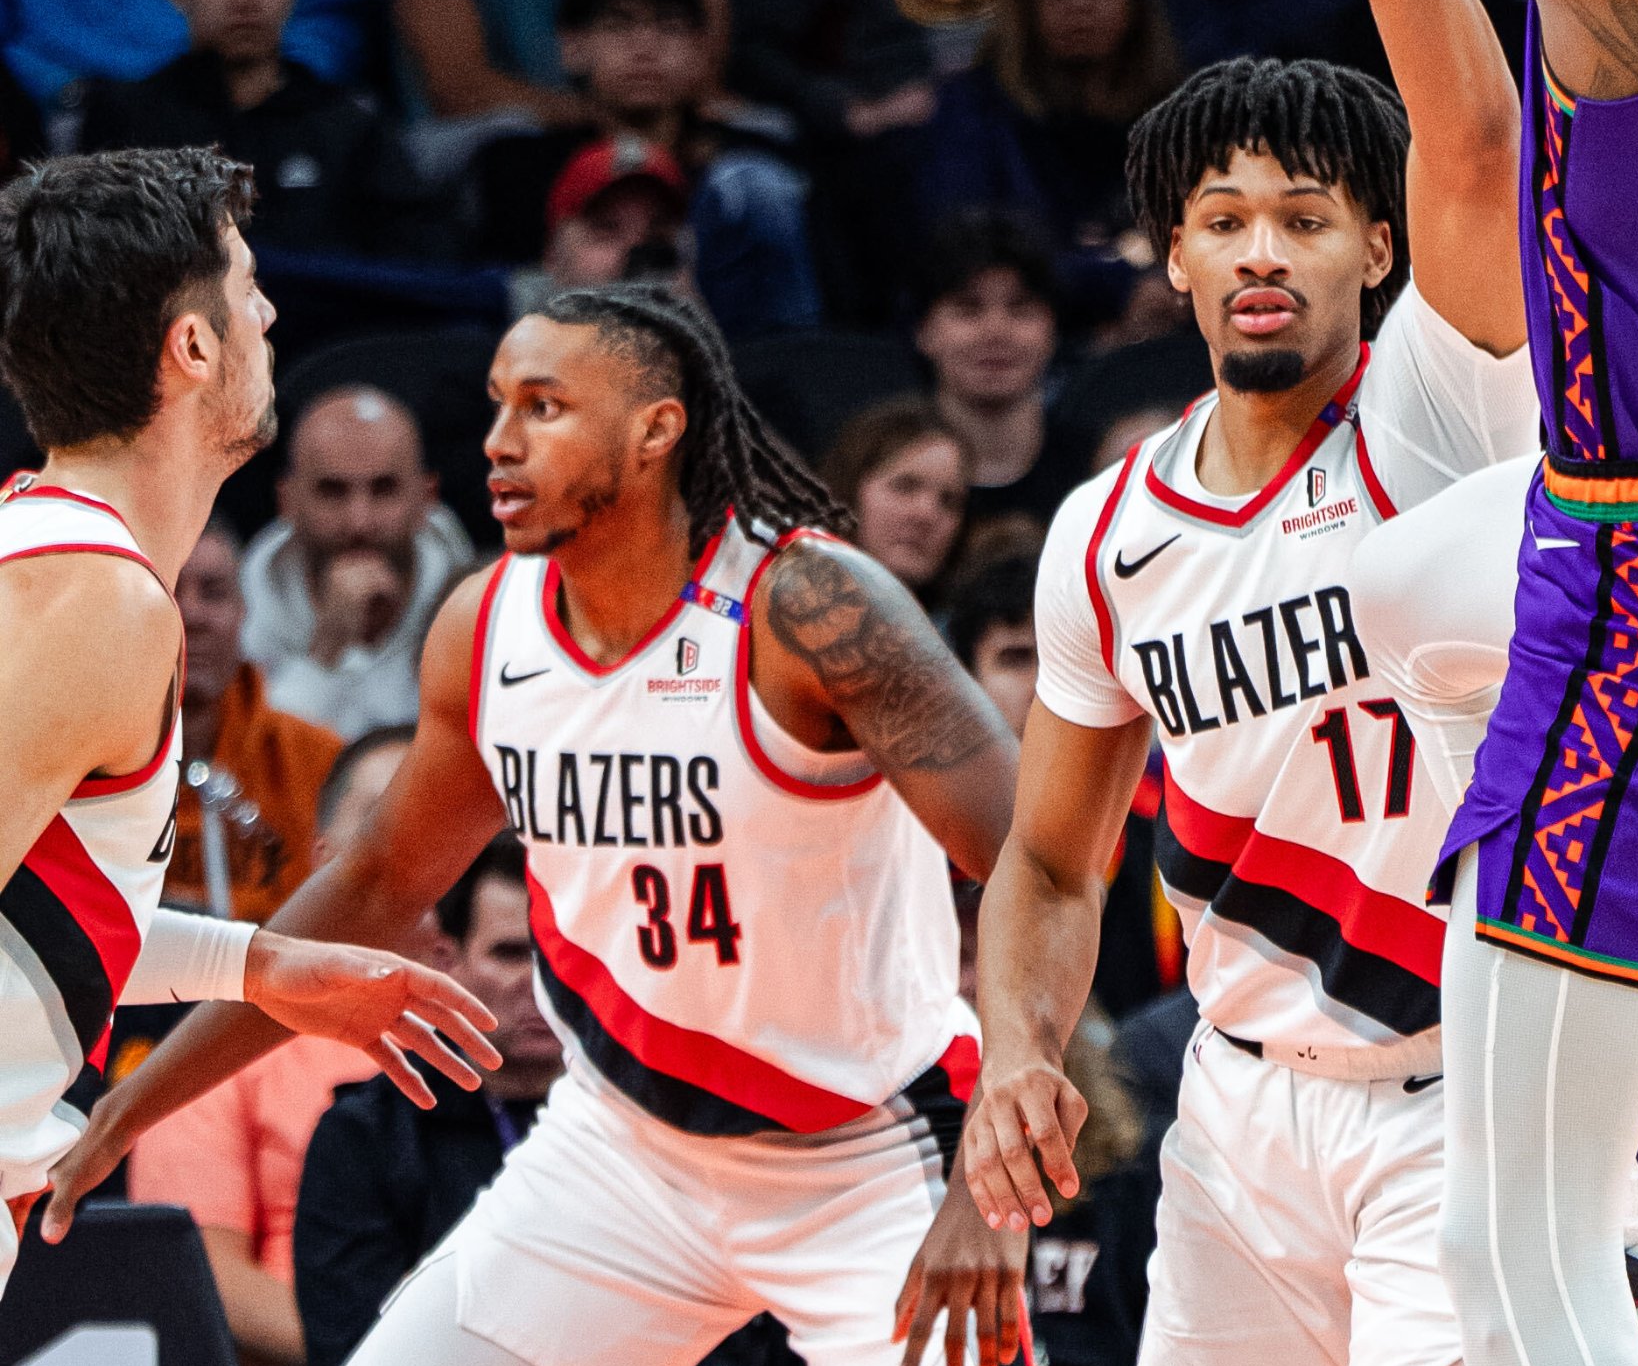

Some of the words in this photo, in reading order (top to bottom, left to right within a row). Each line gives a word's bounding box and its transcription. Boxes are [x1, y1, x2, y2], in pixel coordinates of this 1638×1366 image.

[1282, 498, 1358, 534] BRIGHTSIDE
[1299, 521, 1346, 540] WINDOWS
[647, 678, 721, 693] BRIGHTSIDE
[1311, 697, 1417, 824] 17
[493, 744, 724, 847] BLAZERS
[631, 863, 743, 971] 34
